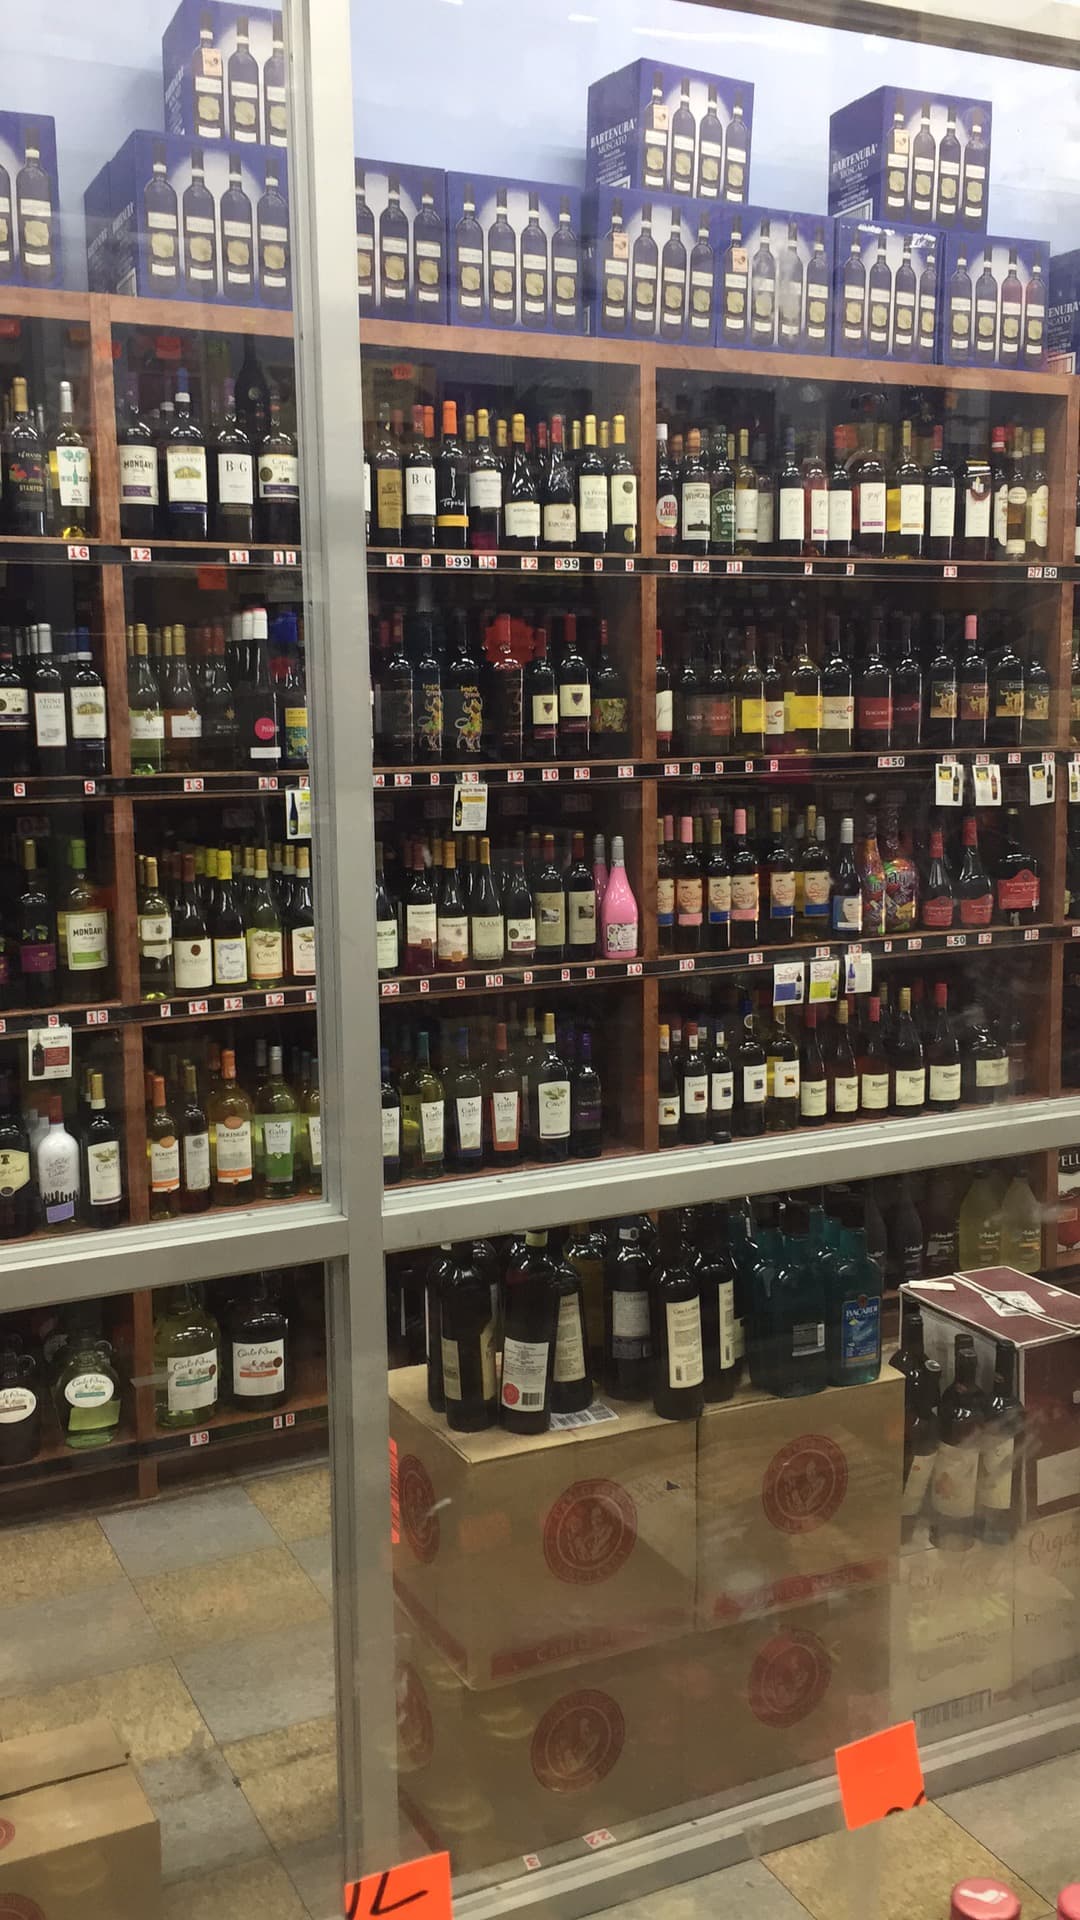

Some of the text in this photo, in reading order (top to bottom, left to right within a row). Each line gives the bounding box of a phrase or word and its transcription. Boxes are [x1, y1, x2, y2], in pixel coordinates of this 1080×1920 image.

[1048, 301, 1079, 318] ENURA
[70, 547, 87, 558] 16
[133, 550, 150, 559] 12
[231, 552, 247, 562] 11
[388, 556, 403, 565] 14
[424, 556, 430, 565] 9
[480, 557, 495, 566] 14
[523, 558, 536, 568] 12
[596, 561, 601, 569] 9
[627, 561, 633, 570] 9
[671, 563, 677, 571] 9
[695, 563, 709, 571] 12
[728, 563, 741, 572] 11
[805, 563, 811, 573] 7
[848, 565, 853, 574] 7
[666, 765, 678, 774] 13
[694, 764, 699, 772] 9
[717, 763, 723, 772] 9
[746, 762, 752, 771] 9
[771, 761, 777, 770] 9
[510, 772, 522, 780] 12
[544, 770, 557, 779] 10
[576, 769, 589, 778] 19
[619, 767, 632, 776] 13
[301, 778, 307, 787] 7
[396, 776, 410, 784] 12
[432, 775, 438, 784] 9
[464, 774, 478, 782] 13
[86, 782, 93, 792] 6
[186, 780, 202, 790] 13
[261, 778, 277, 788] 10
[15, 784, 23, 793] 6
[72, 926, 104, 936] MONDAVI
[980, 934, 991, 943] 12
[849, 945, 861, 953] 12
[885, 941, 891, 951] 7
[629, 965, 641, 973] 10
[681, 960, 694, 969] 10
[525, 973, 531, 982] 9
[563, 970, 568, 979] 9
[588, 969, 593, 977] 9
[458, 979, 464, 988] 9
[487, 976, 502, 986] 10
[384, 985, 399, 993] 22
[422, 982, 428, 991] 9
[226, 1000, 241, 1009] 12
[268, 995, 283, 1005] 12
[163, 1006, 169, 1015] 7
[191, 1002, 206, 1012] 14
[50, 1016, 57, 1026] 9
[88, 1013, 107, 1023] 13
[1061, 1153, 1080, 1166] ELL
[275, 1415, 294, 1426] 18
[192, 1433, 208, 1444] 19
